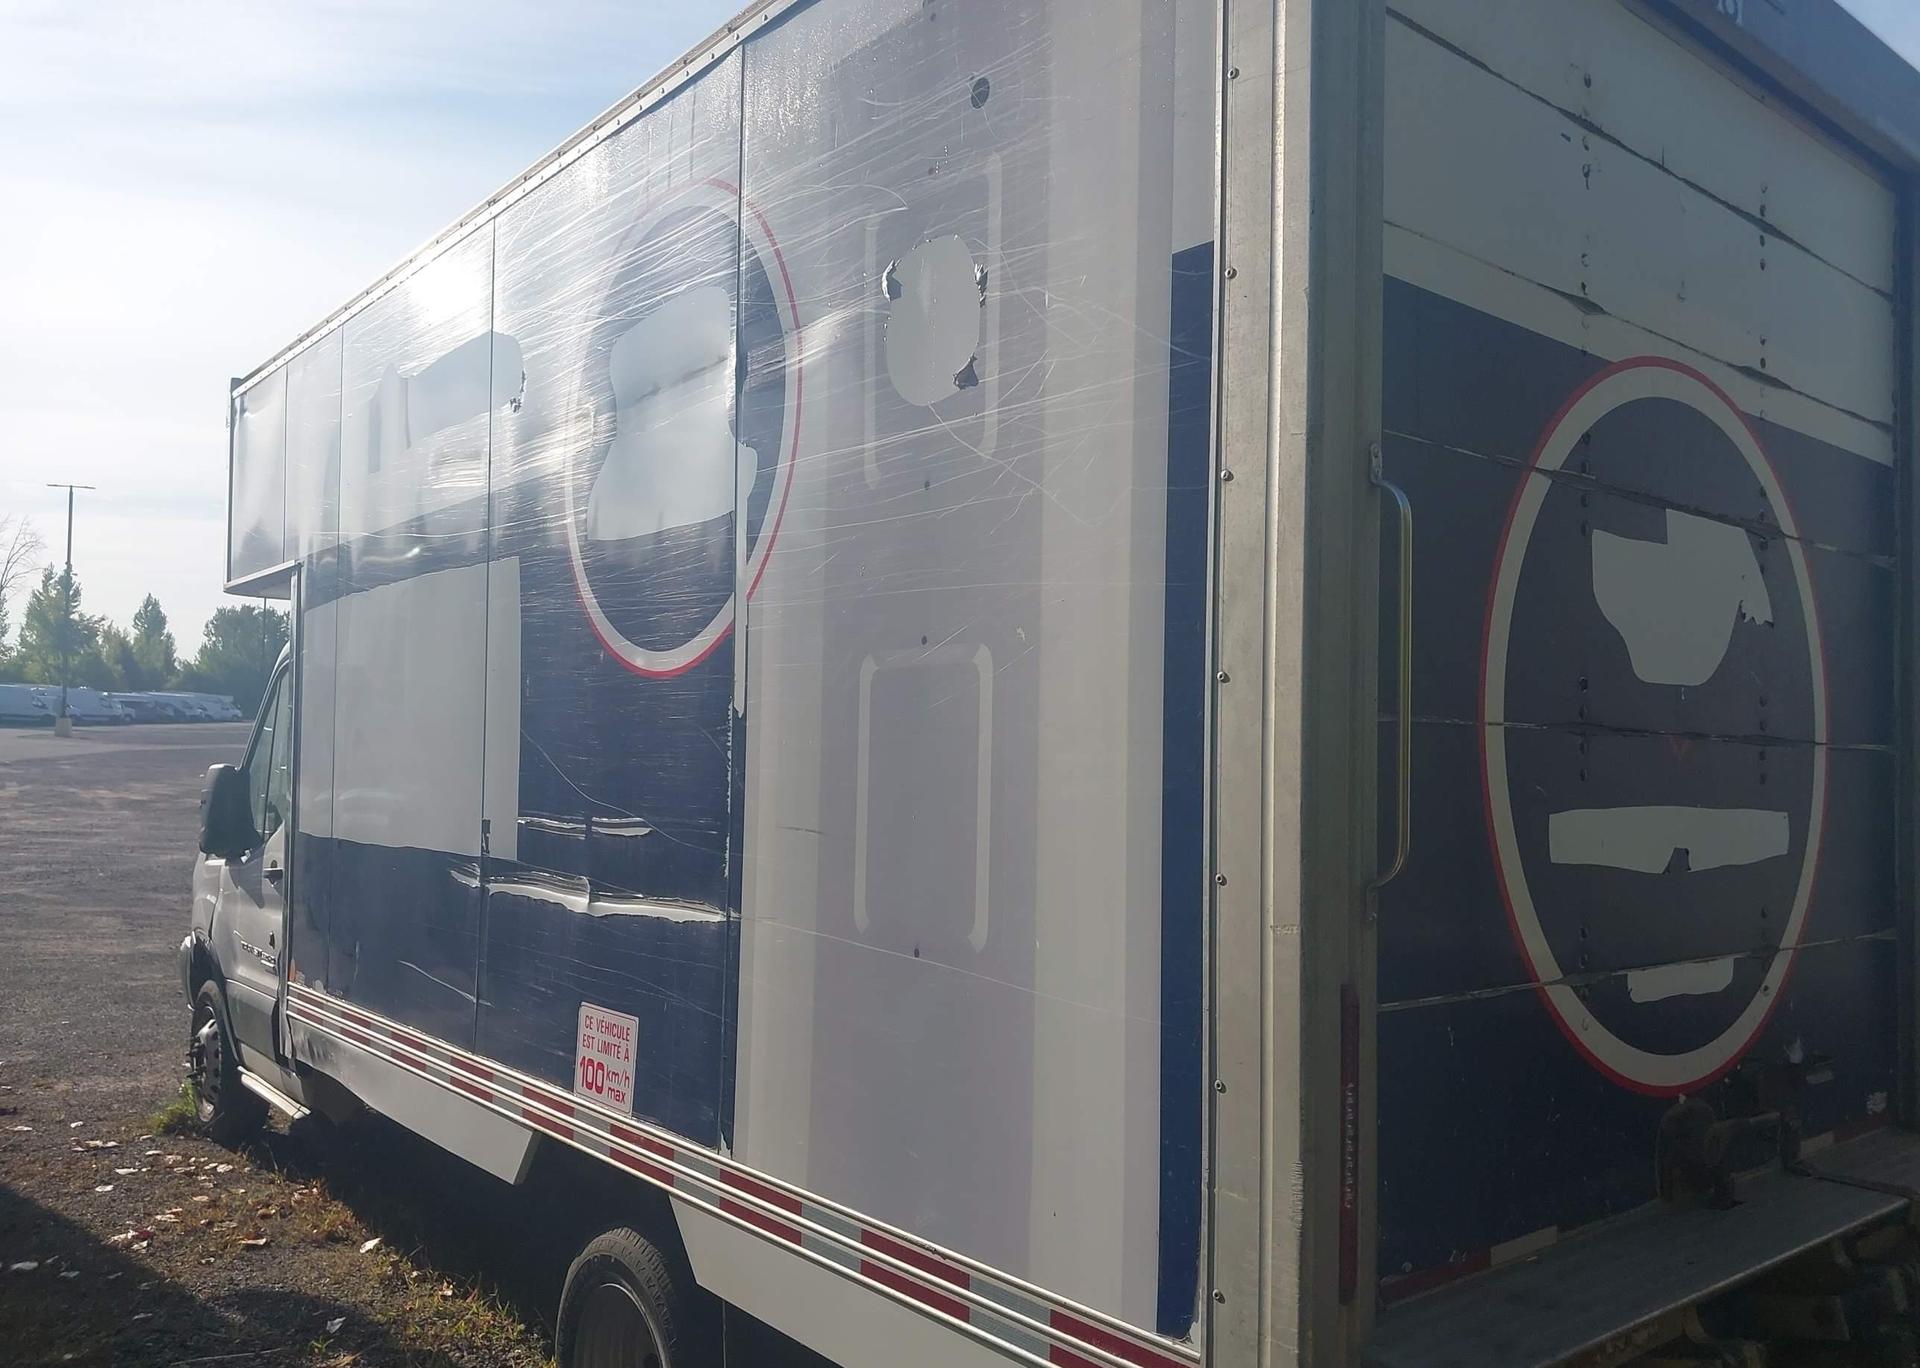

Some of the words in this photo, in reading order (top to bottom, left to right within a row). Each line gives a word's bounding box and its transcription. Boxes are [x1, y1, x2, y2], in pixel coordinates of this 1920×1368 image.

[585, 1015, 593, 1030] CE
[596, 1016, 630, 1041] VÉHICULE
[582, 1034, 595, 1051] EST
[597, 1039, 621, 1060] LIMITÉ
[623, 1043, 630, 1063] À
[580, 1056, 605, 1094] 100
[606, 1065, 630, 1088] km/h
[607, 1087, 626, 1104] max
